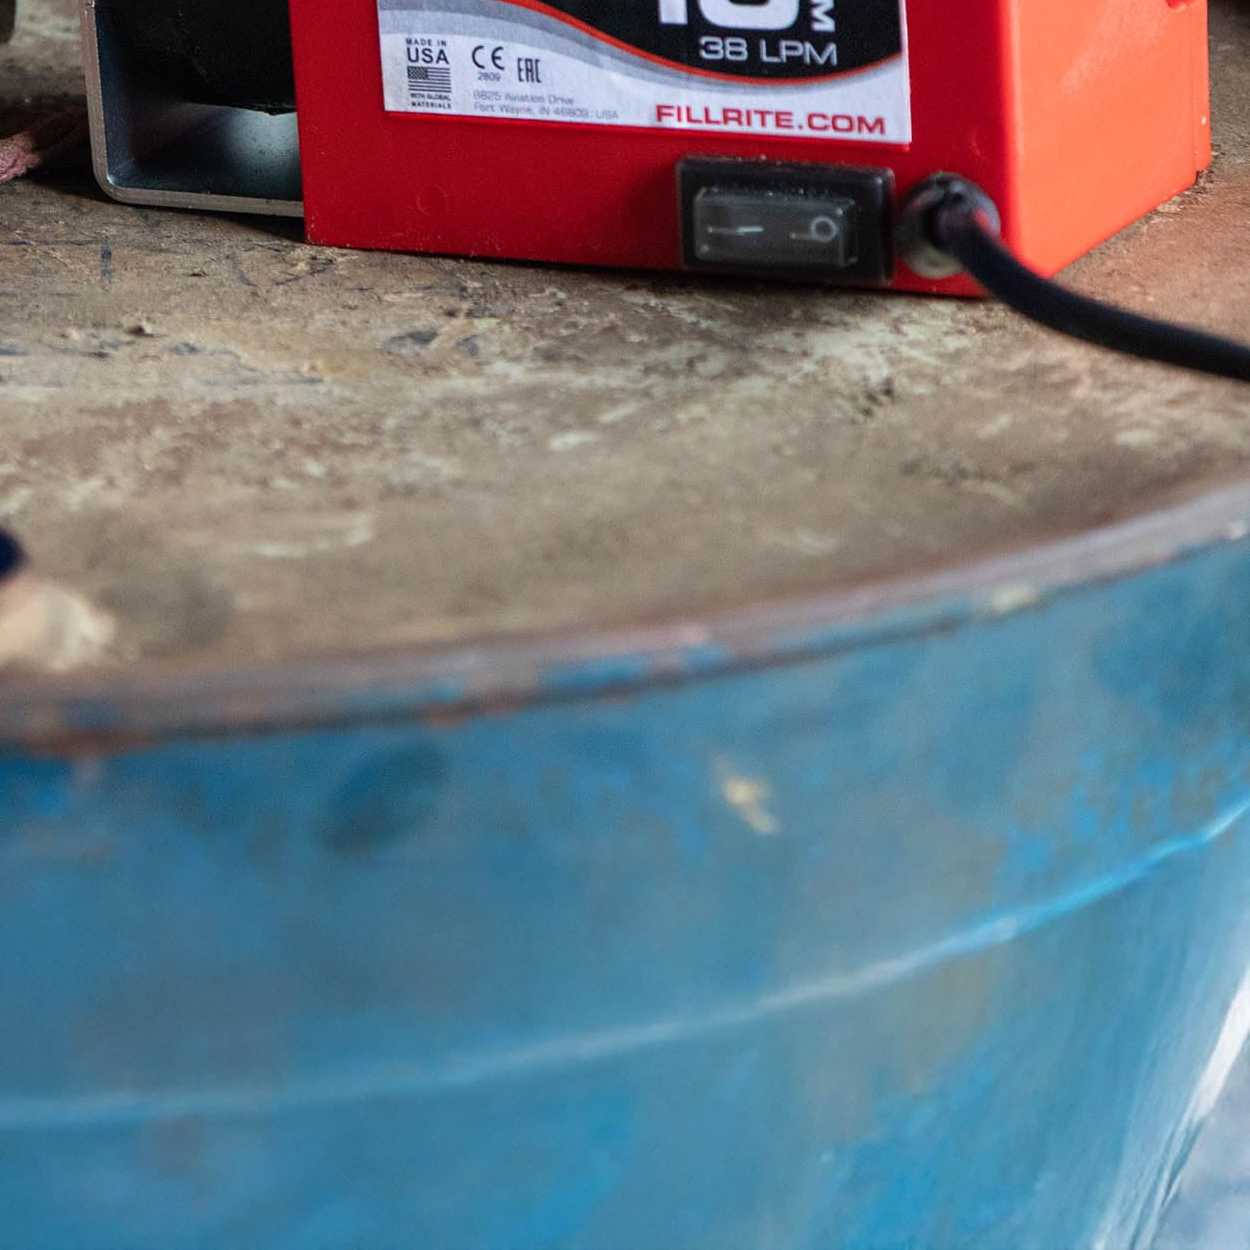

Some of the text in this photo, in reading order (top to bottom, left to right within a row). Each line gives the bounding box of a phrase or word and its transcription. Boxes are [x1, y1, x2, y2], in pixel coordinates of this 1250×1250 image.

[406, 38, 432, 46] MADE
[407, 47, 449, 64] USA
[699, 36, 838, 66] 38 LPM
[548, 94, 574, 105] Drive
[656, 105, 885, 135] FILLRITE.COM
